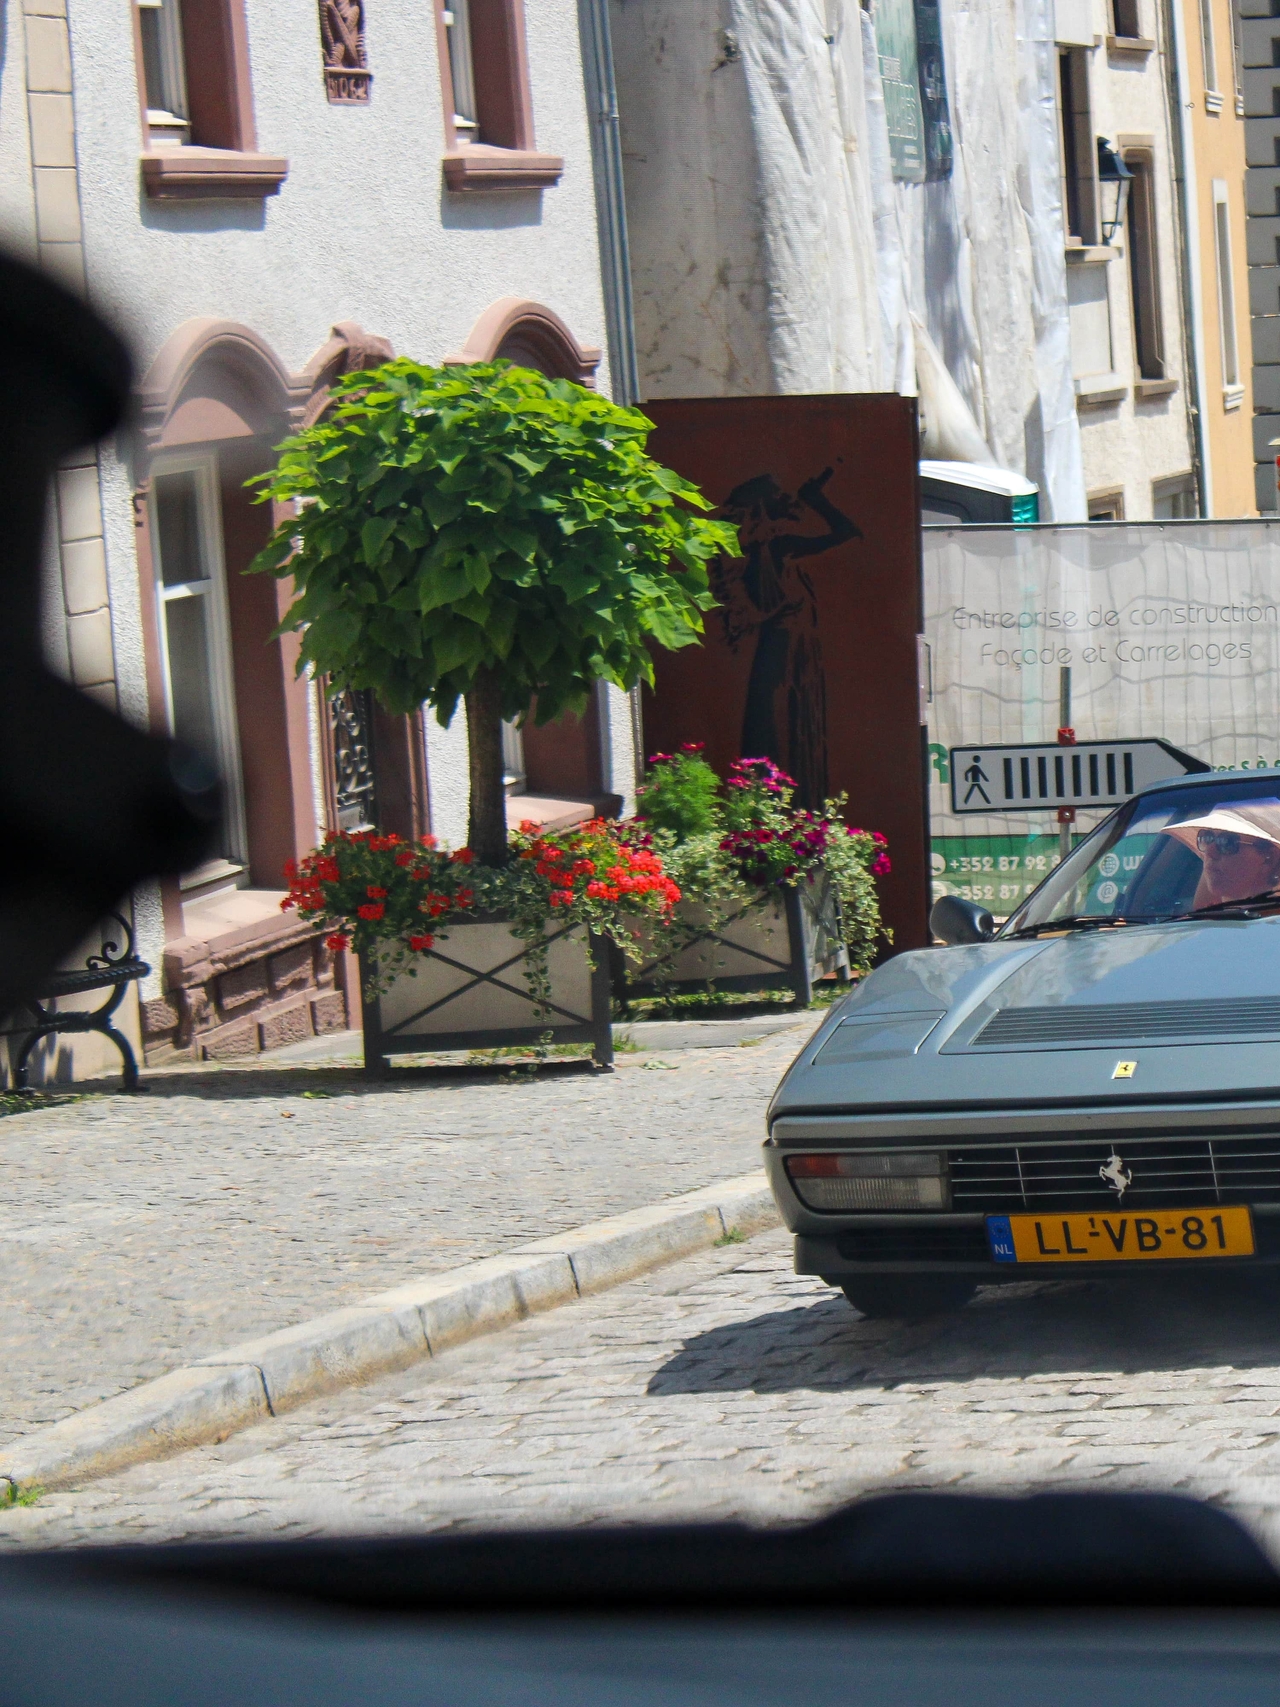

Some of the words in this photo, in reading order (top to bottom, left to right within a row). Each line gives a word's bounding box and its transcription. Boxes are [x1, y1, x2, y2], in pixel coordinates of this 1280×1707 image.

[953, 606, 1079, 635] Entreprise
[1087, 605, 1120, 628] de
[1129, 601, 1278, 626] construction
[981, 642, 1073, 672] Façade
[1082, 644, 1107, 664] et
[1116, 638, 1252, 667] Carrelages
[950, 856, 995, 872] +352
[998, 856, 1020, 872] 87
[1025, 856, 1047, 871] 92
[952, 885, 995, 900] +352
[1000, 884, 1021, 900] 87
[994, 1244, 1013, 1256] NL
[1034, 1215, 1227, 1255] LL-VB-81
